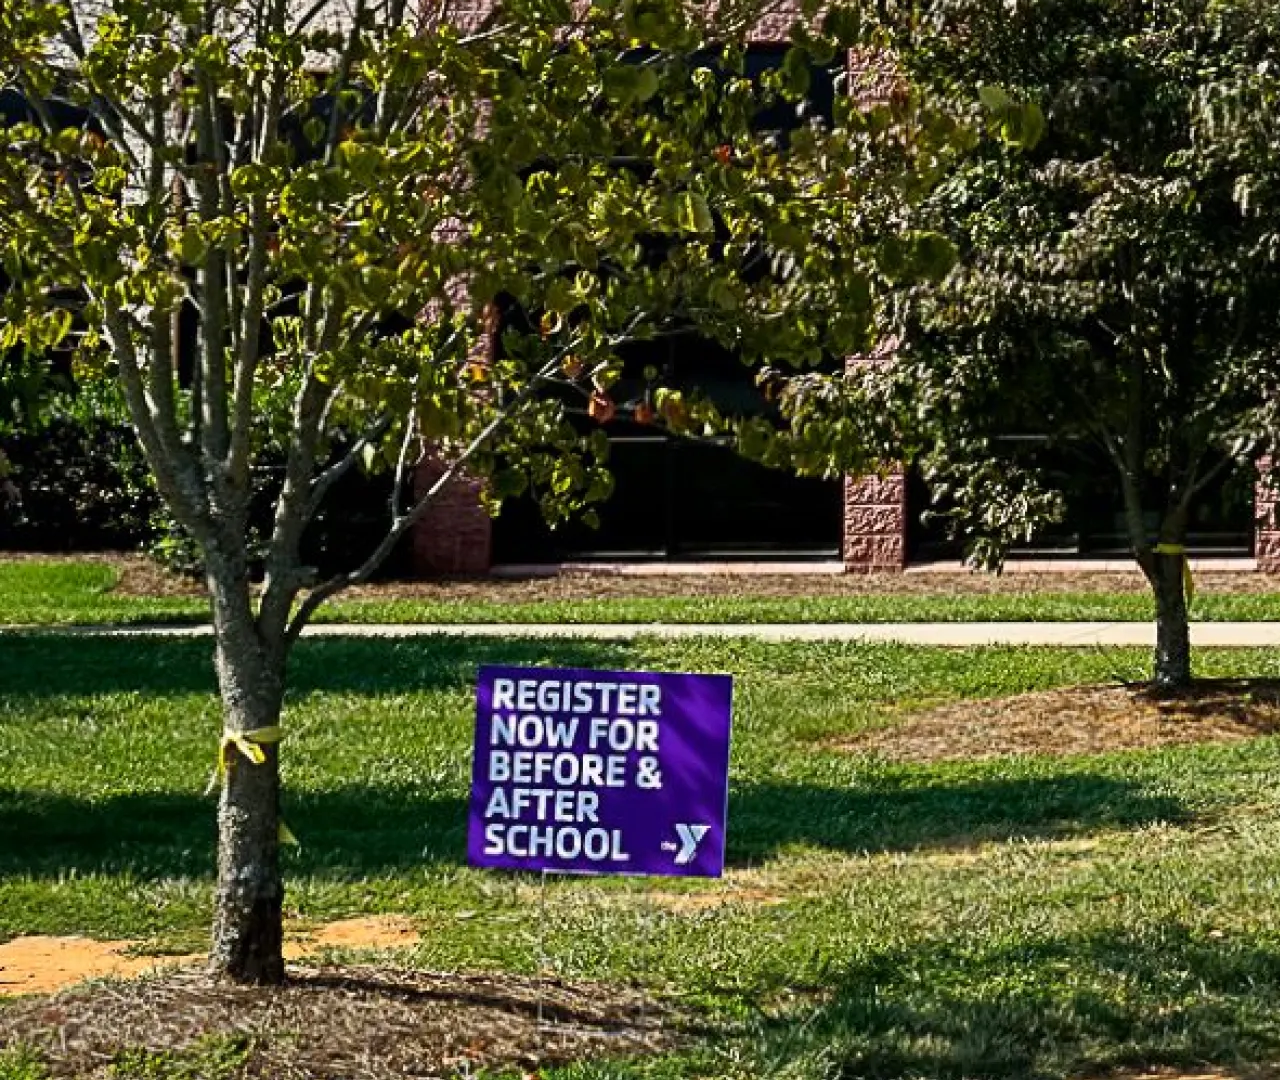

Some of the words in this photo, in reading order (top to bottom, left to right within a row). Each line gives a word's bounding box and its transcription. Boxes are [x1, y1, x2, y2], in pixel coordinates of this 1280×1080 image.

[492, 678, 662, 716] REGISTER
[490, 715, 579, 748] NOW
[589, 718, 659, 751] FOR
[488, 750, 627, 787] BEFORE
[635, 756, 662, 789] &
[485, 786, 599, 822] AFTER
[484, 823, 631, 861] SCHOOL
